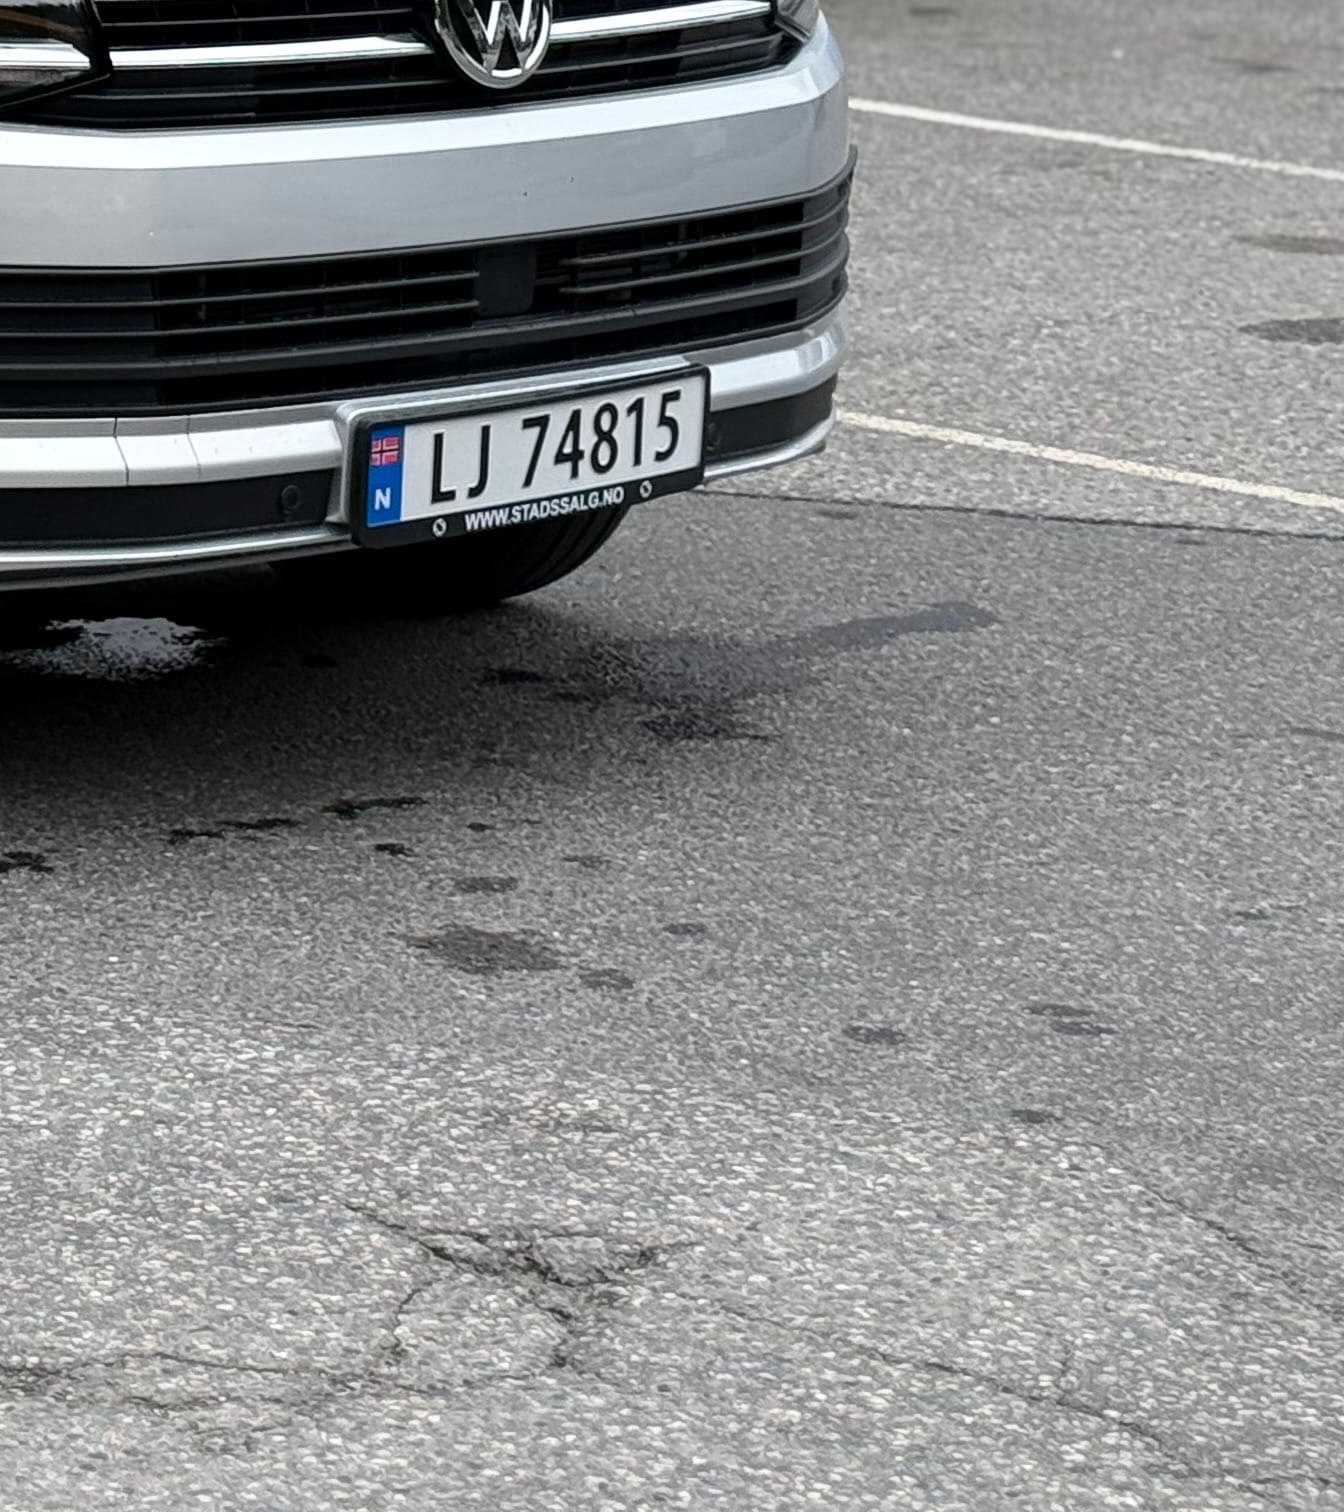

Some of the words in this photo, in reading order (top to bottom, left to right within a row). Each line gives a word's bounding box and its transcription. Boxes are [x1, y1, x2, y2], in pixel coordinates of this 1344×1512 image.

[431, 425, 491, 504] LJ
[522, 391, 681, 487] 74815
[374, 487, 392, 511] N
[465, 489, 624, 531] WWW.STADSSALG.NO
